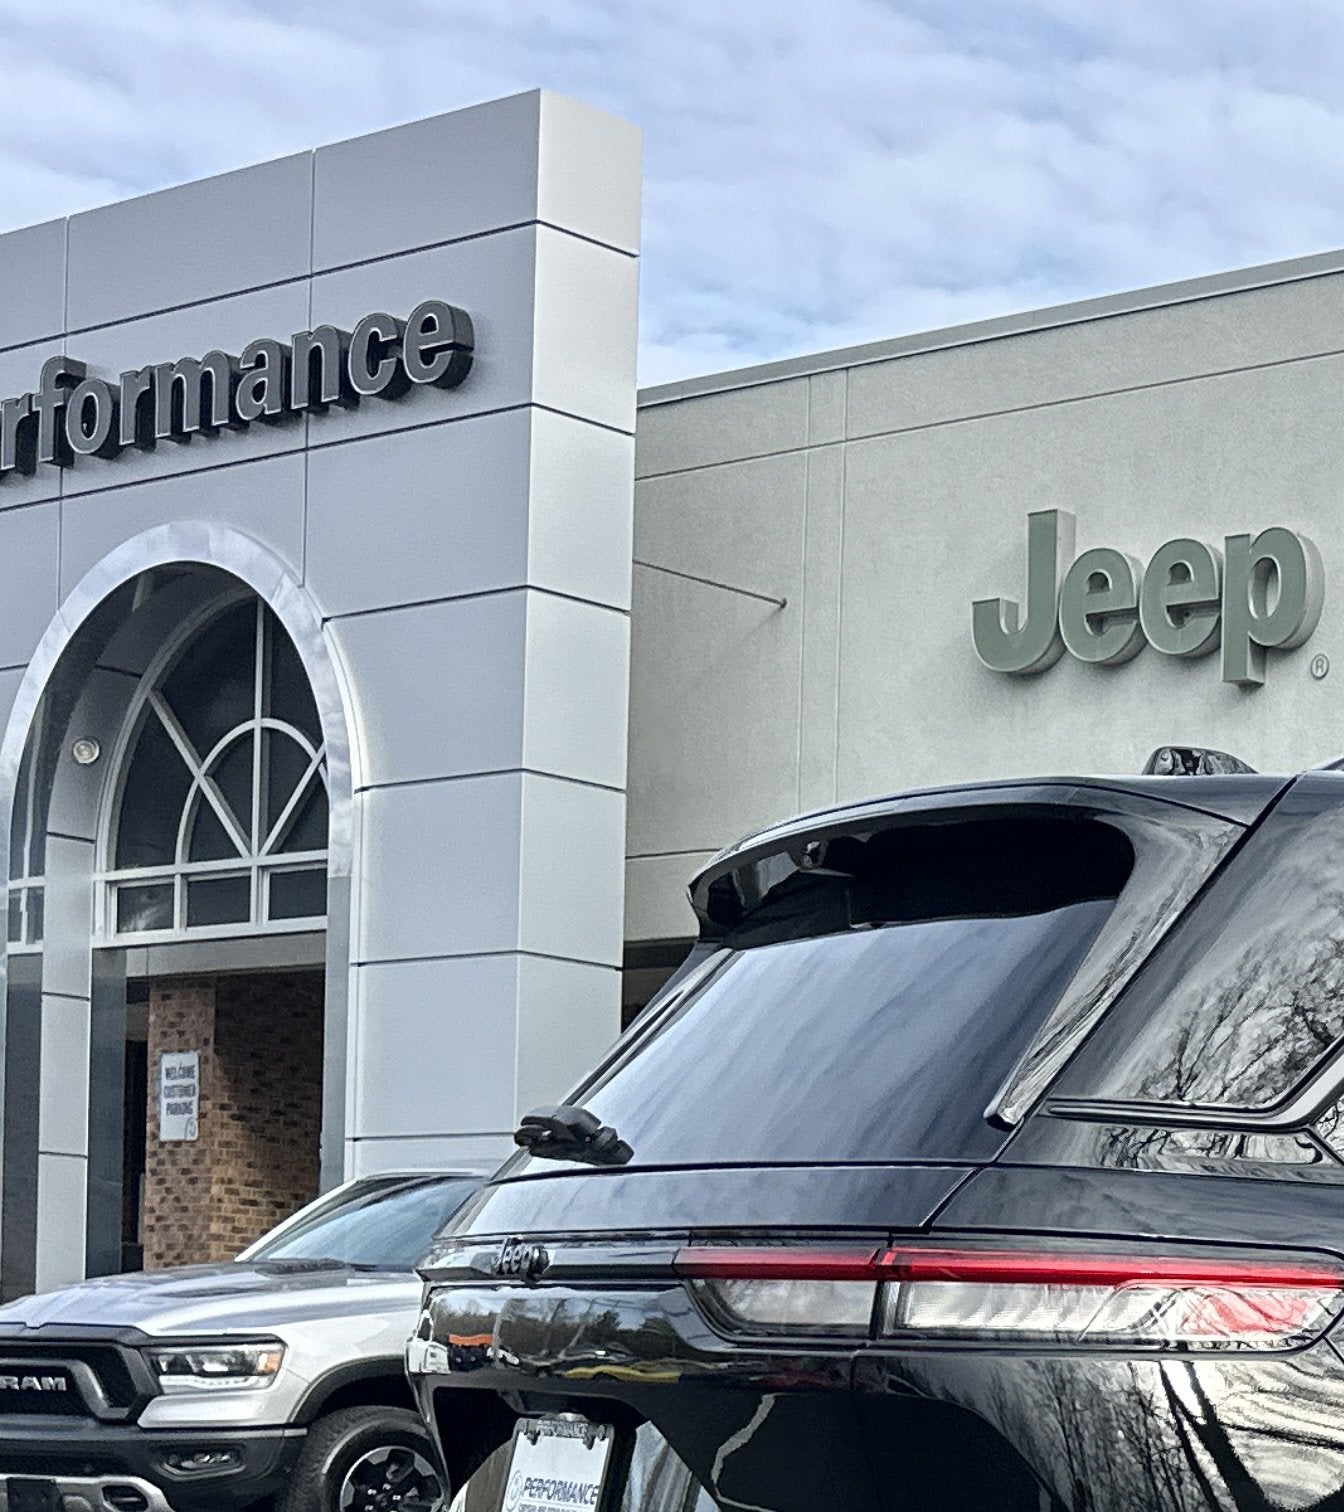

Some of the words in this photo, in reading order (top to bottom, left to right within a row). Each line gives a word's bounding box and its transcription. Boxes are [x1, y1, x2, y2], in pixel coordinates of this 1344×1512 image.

[971, 508, 1326, 687] Jeep
[0, 1375, 68, 1392] RAM
[521, 1476, 601, 1506] PERFORMANCE
